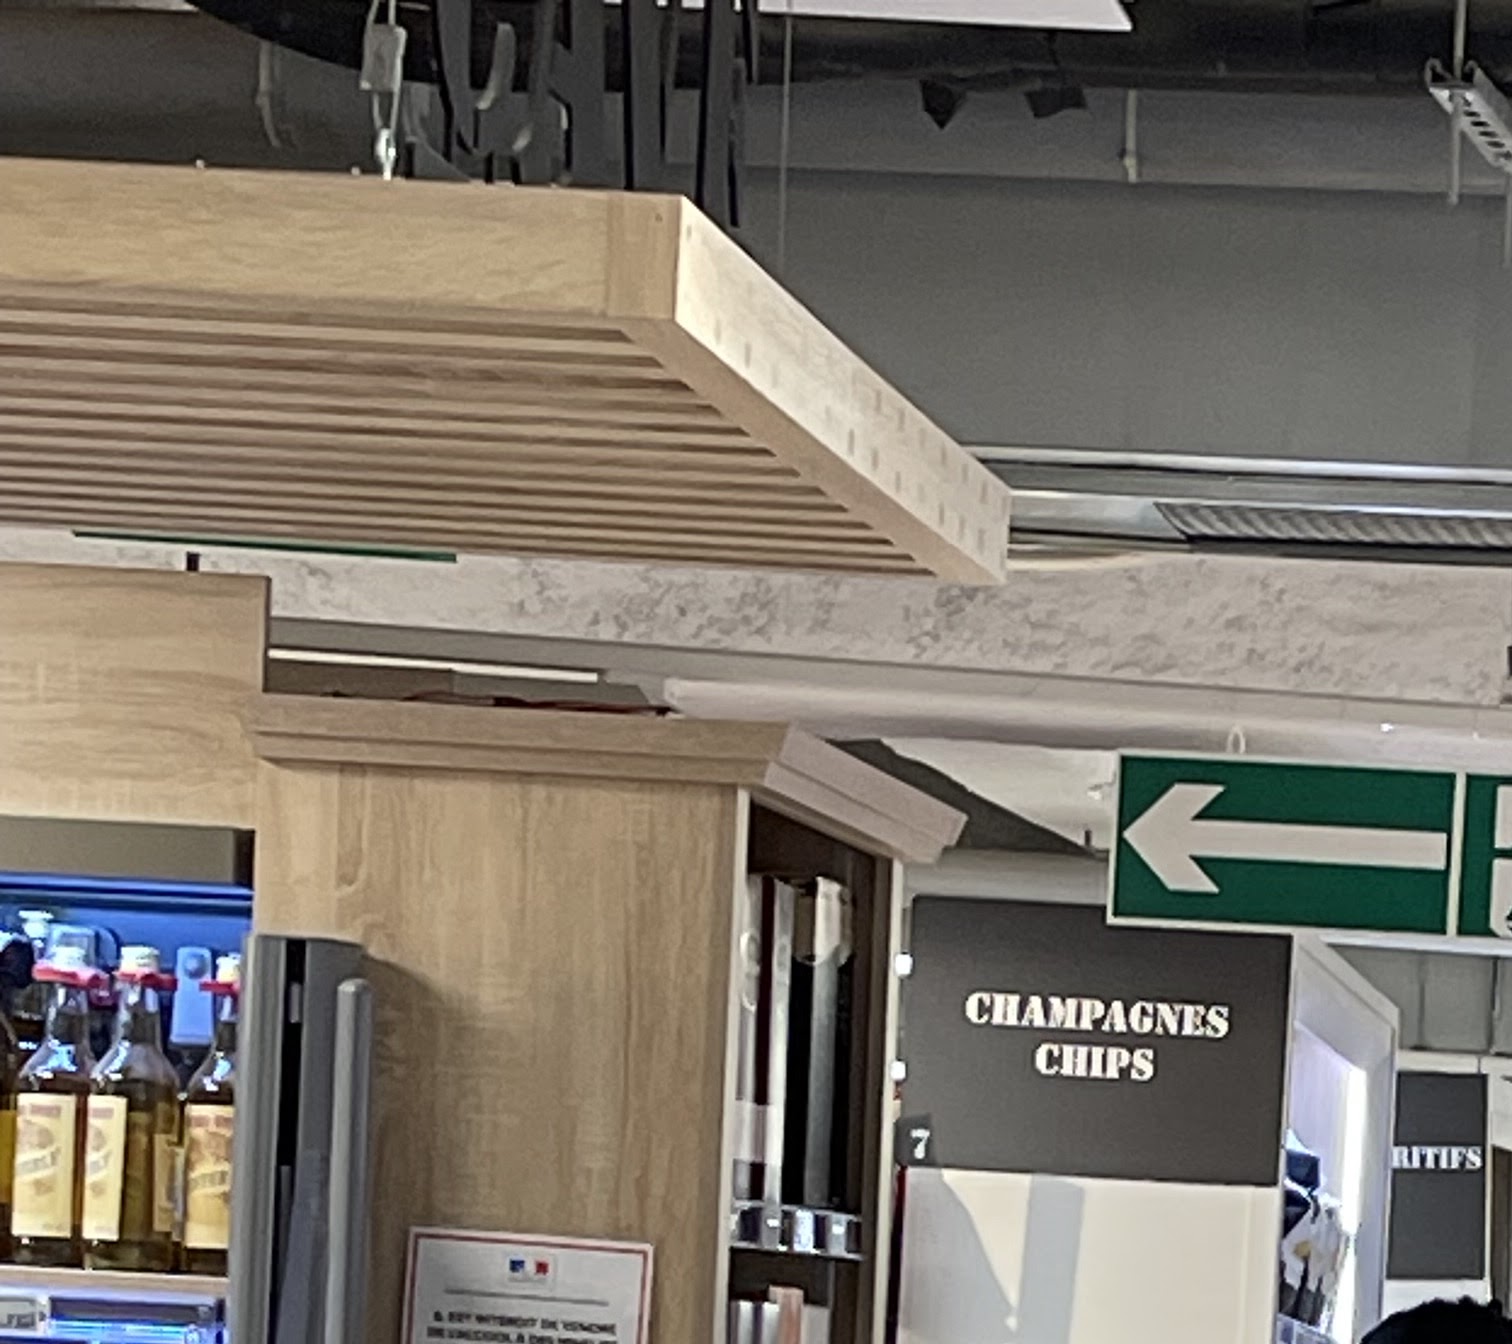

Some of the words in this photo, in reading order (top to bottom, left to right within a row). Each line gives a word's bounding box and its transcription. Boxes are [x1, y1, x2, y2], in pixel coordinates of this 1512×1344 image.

[965, 991, 1230, 1039] CHAMPAGNES
[1035, 1043, 1155, 1081] CHIPS
[910, 1128, 930, 1159] 7
